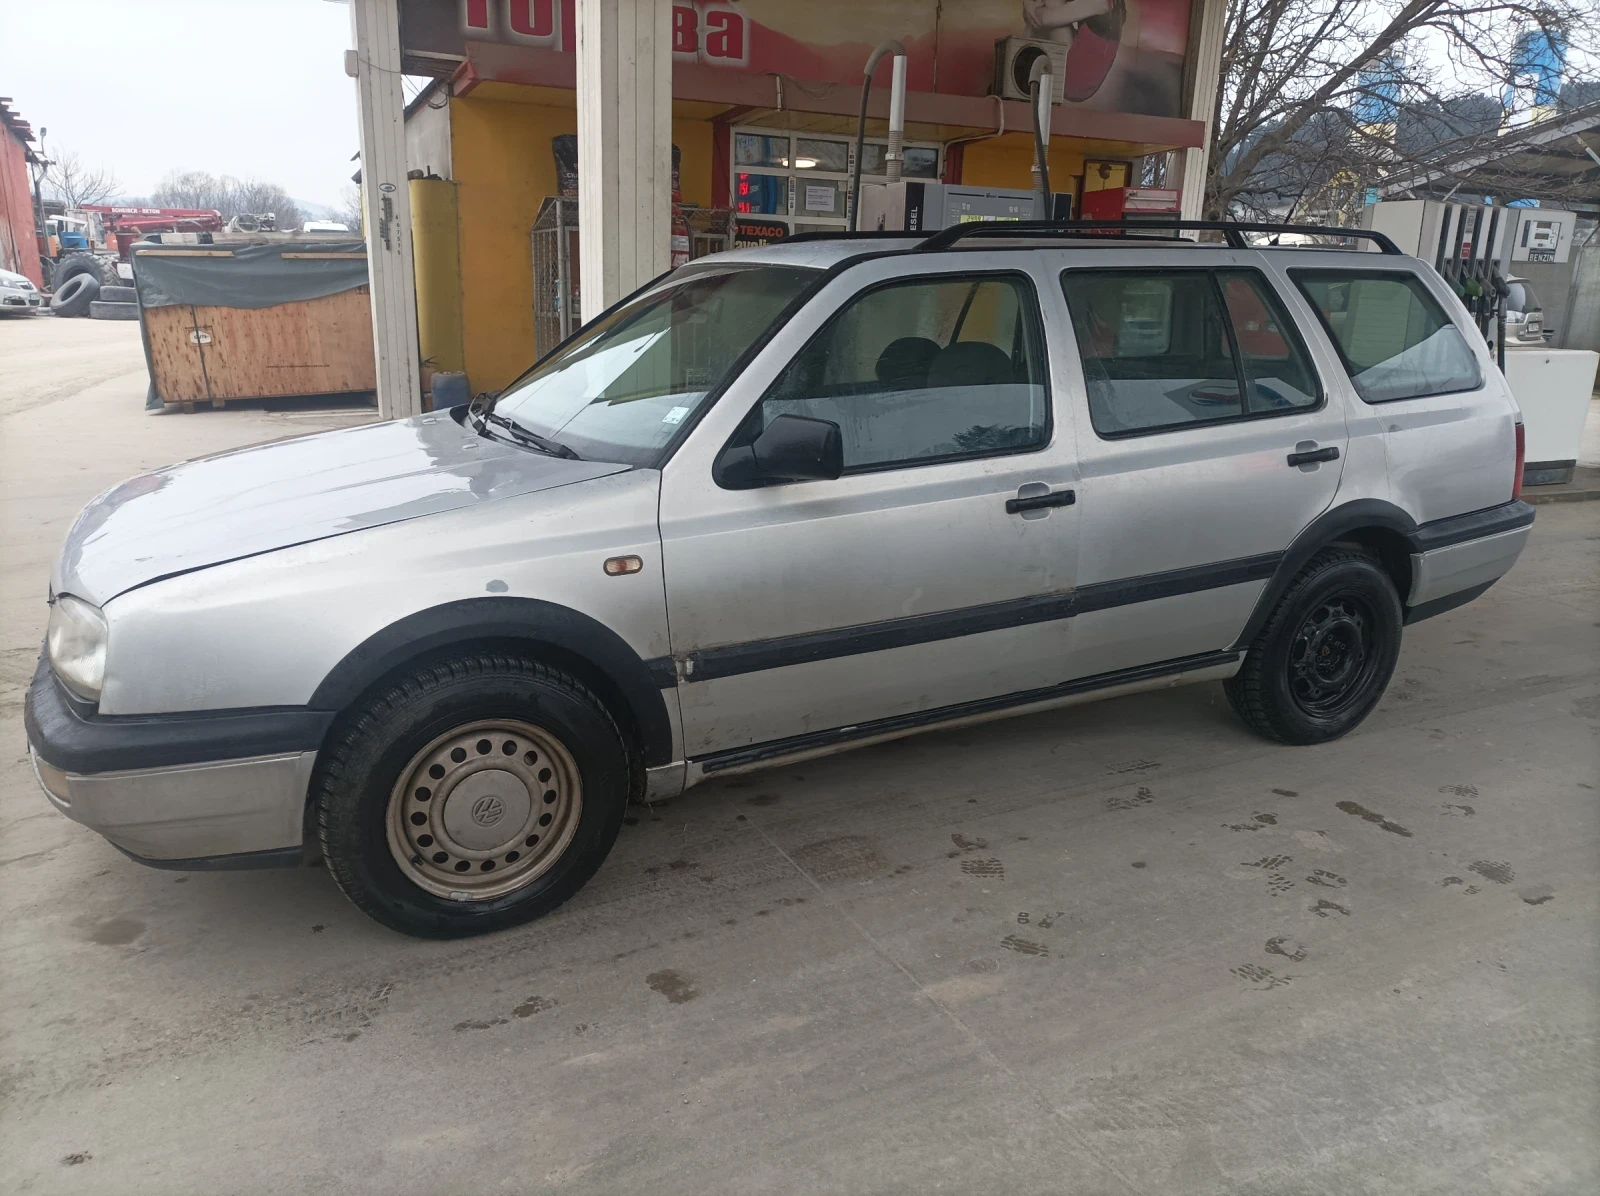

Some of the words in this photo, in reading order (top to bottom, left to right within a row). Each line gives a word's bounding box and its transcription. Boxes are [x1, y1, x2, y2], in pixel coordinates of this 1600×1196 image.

[909, 206, 918, 231] ESEL
[740, 225, 784, 237] TEXACO
[1529, 253, 1554, 262] BENZIN
